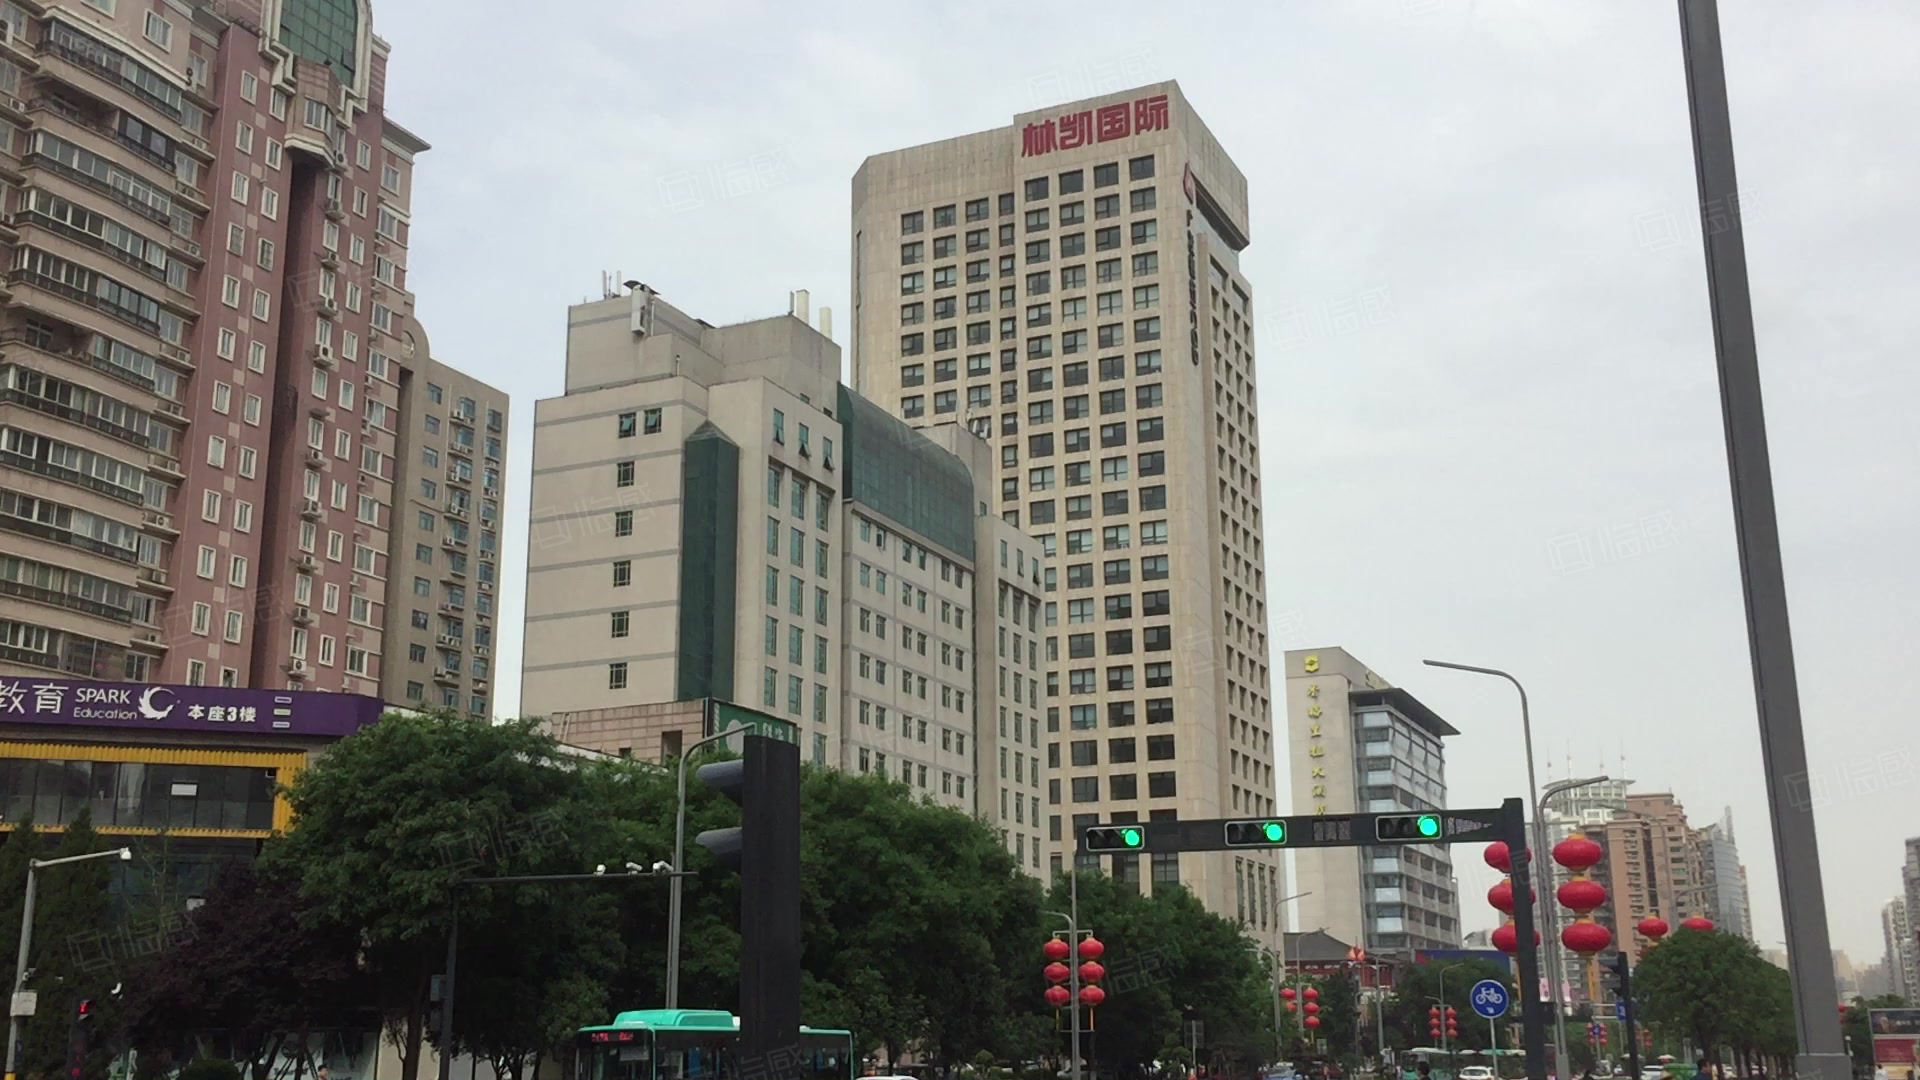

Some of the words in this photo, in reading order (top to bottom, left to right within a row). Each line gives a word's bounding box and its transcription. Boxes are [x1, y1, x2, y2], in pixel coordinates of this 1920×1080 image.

[1021, 94, 1169, 158] 林凯国际
[0, 680, 69, 714] 教育
[75, 687, 131, 705] SPARK
[73, 706, 137, 721] Education
[187, 703, 257, 723] 本座3楼
